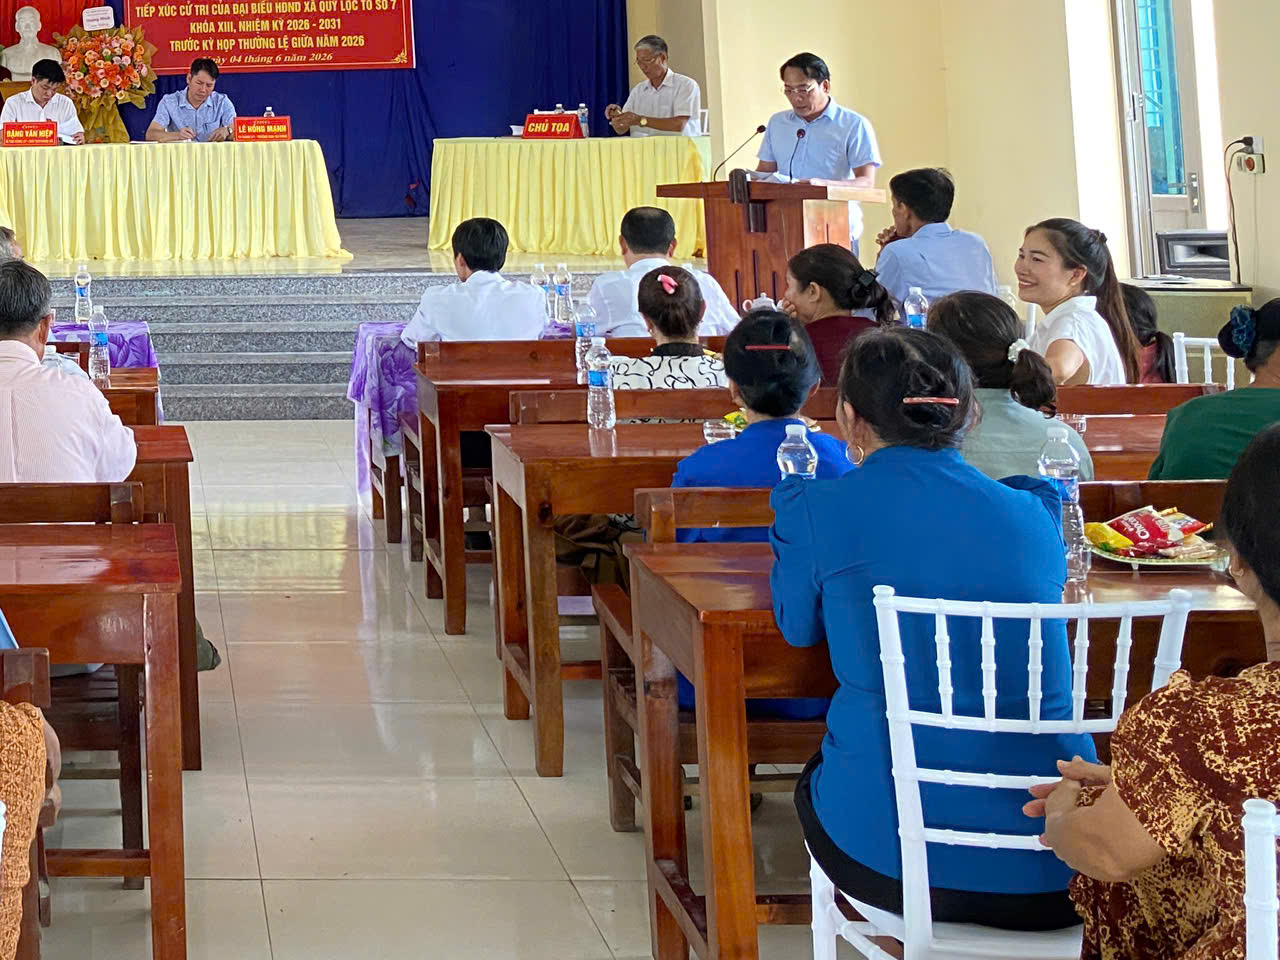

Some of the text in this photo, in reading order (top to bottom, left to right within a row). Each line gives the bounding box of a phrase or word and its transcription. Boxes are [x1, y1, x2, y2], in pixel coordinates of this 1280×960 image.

[136, 3, 155, 17] TIẾP
[158, 3, 177, 16] XÚC
[194, 4, 209, 15] TRI
[304, 0, 316, 12] XÃ
[390, 0, 396, 9] 7
[190, 18, 340, 34] KHÓA XIII, NHIỆM KỲ 2026 2031
[170, 37, 199, 51] TRƯỚC
[202, 37, 214, 50] KỲ
[217, 39, 235, 52] HỌP
[238, 35, 275, 49] THƯỜNG
[278, 35, 288, 50] LỆ
[316, 34, 338, 47] NĂM
[341, 35, 364, 46] 2026
[244, 55, 273, 64] tháng
[275, 54, 281, 62] 6
[309, 53, 333, 61] 2026
[528, 119, 569, 134] CHỦ TỌA
